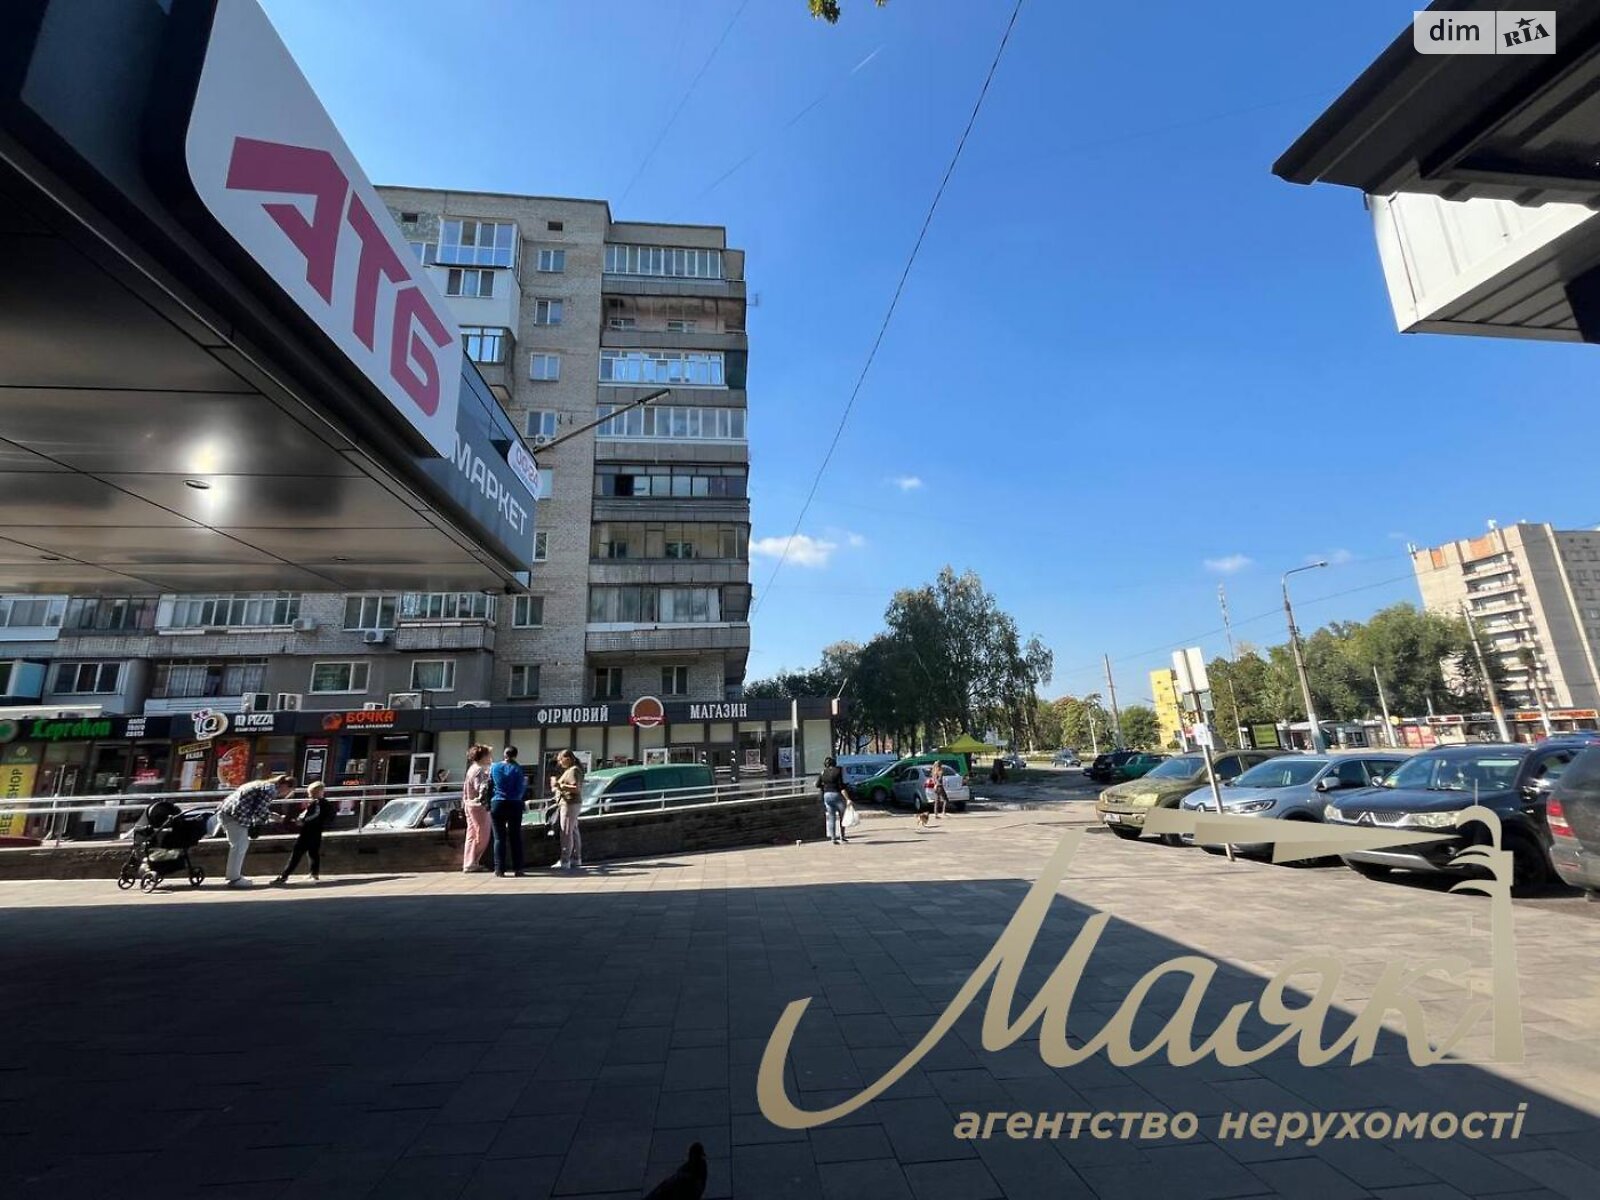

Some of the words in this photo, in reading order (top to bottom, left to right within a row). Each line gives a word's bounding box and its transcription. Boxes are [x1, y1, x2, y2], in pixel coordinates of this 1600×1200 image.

[226, 136, 455, 417] АТБ
[247, 713, 275, 726] PIZZA
[345, 710, 395, 722] БОЧКА
[536, 705, 609, 723] ФІРМОВИЙ
[689, 703, 748, 719] МАГАЗИН
